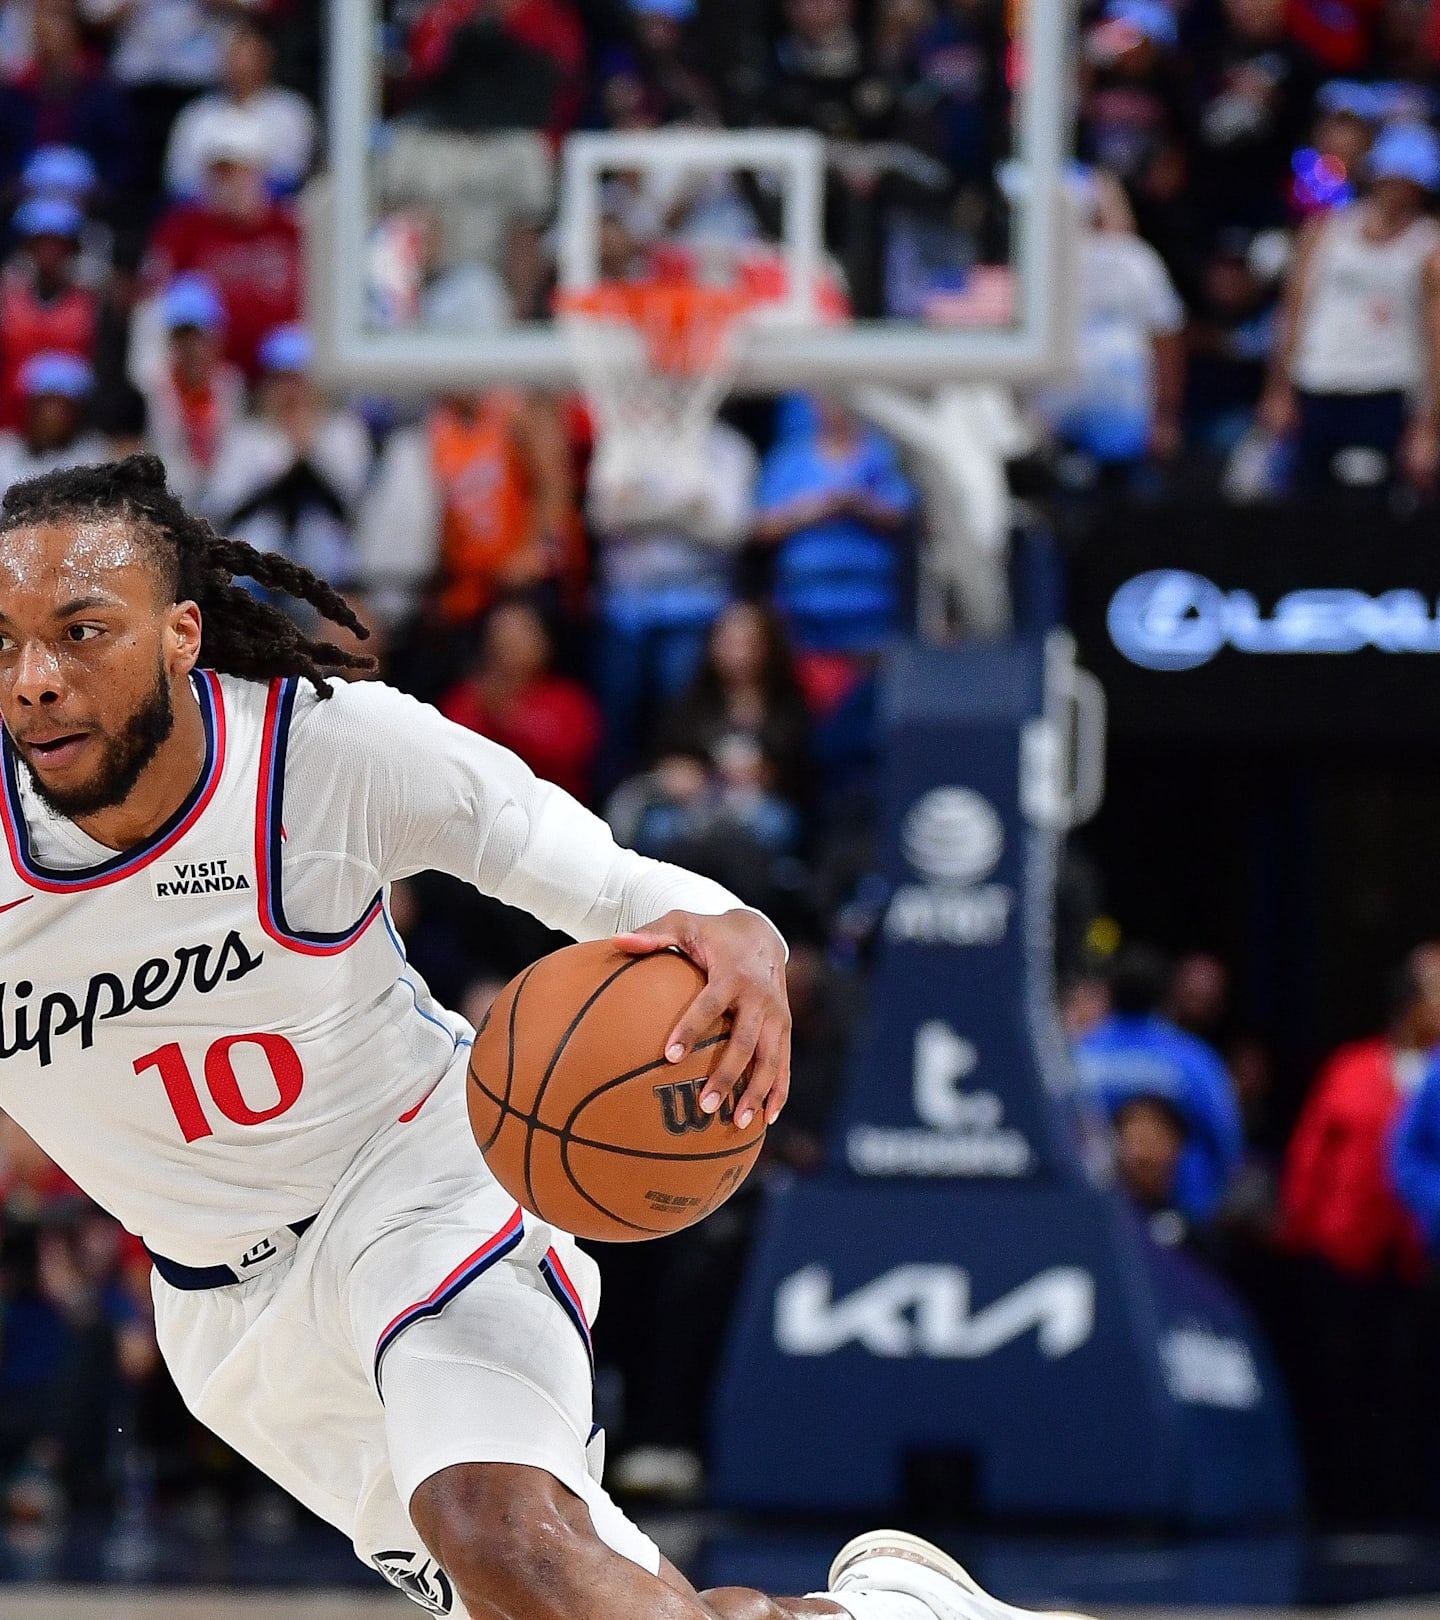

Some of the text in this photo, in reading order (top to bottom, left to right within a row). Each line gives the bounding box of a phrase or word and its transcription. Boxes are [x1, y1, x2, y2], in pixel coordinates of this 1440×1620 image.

[174, 860, 227, 879] VISIT
[156, 874, 250, 897] RWANDA
[132, 1032, 304, 1144] 10
